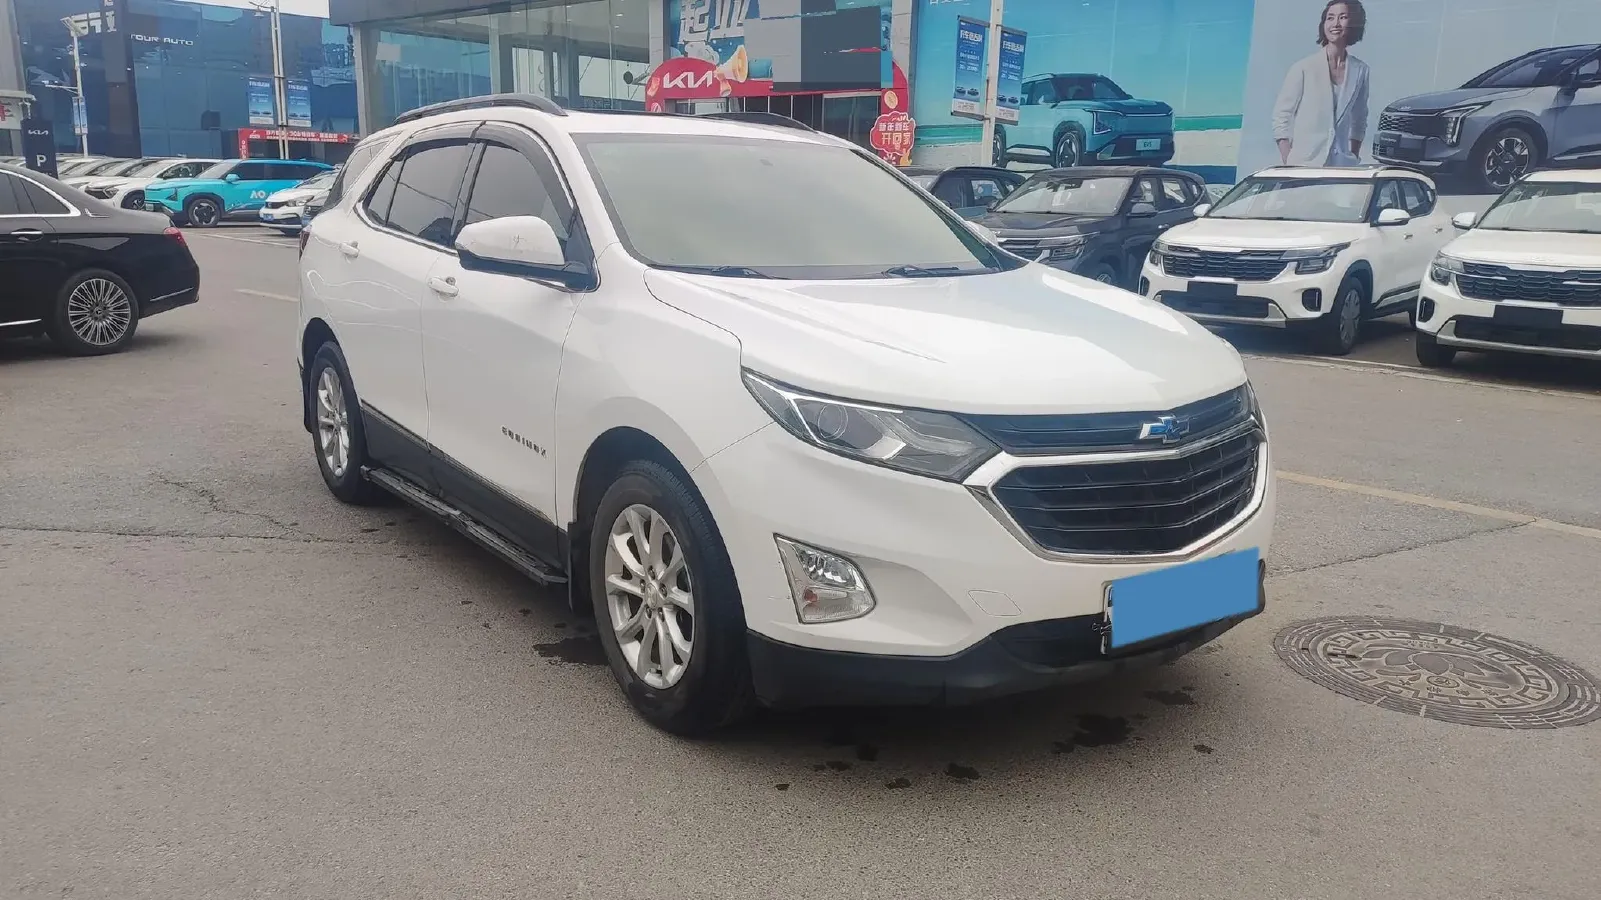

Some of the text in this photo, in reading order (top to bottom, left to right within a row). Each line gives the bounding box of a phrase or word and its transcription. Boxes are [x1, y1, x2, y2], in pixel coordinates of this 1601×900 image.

[163, 37, 194, 46] AUTO
[662, 70, 713, 89] KIA
[36, 154, 47, 167] P
